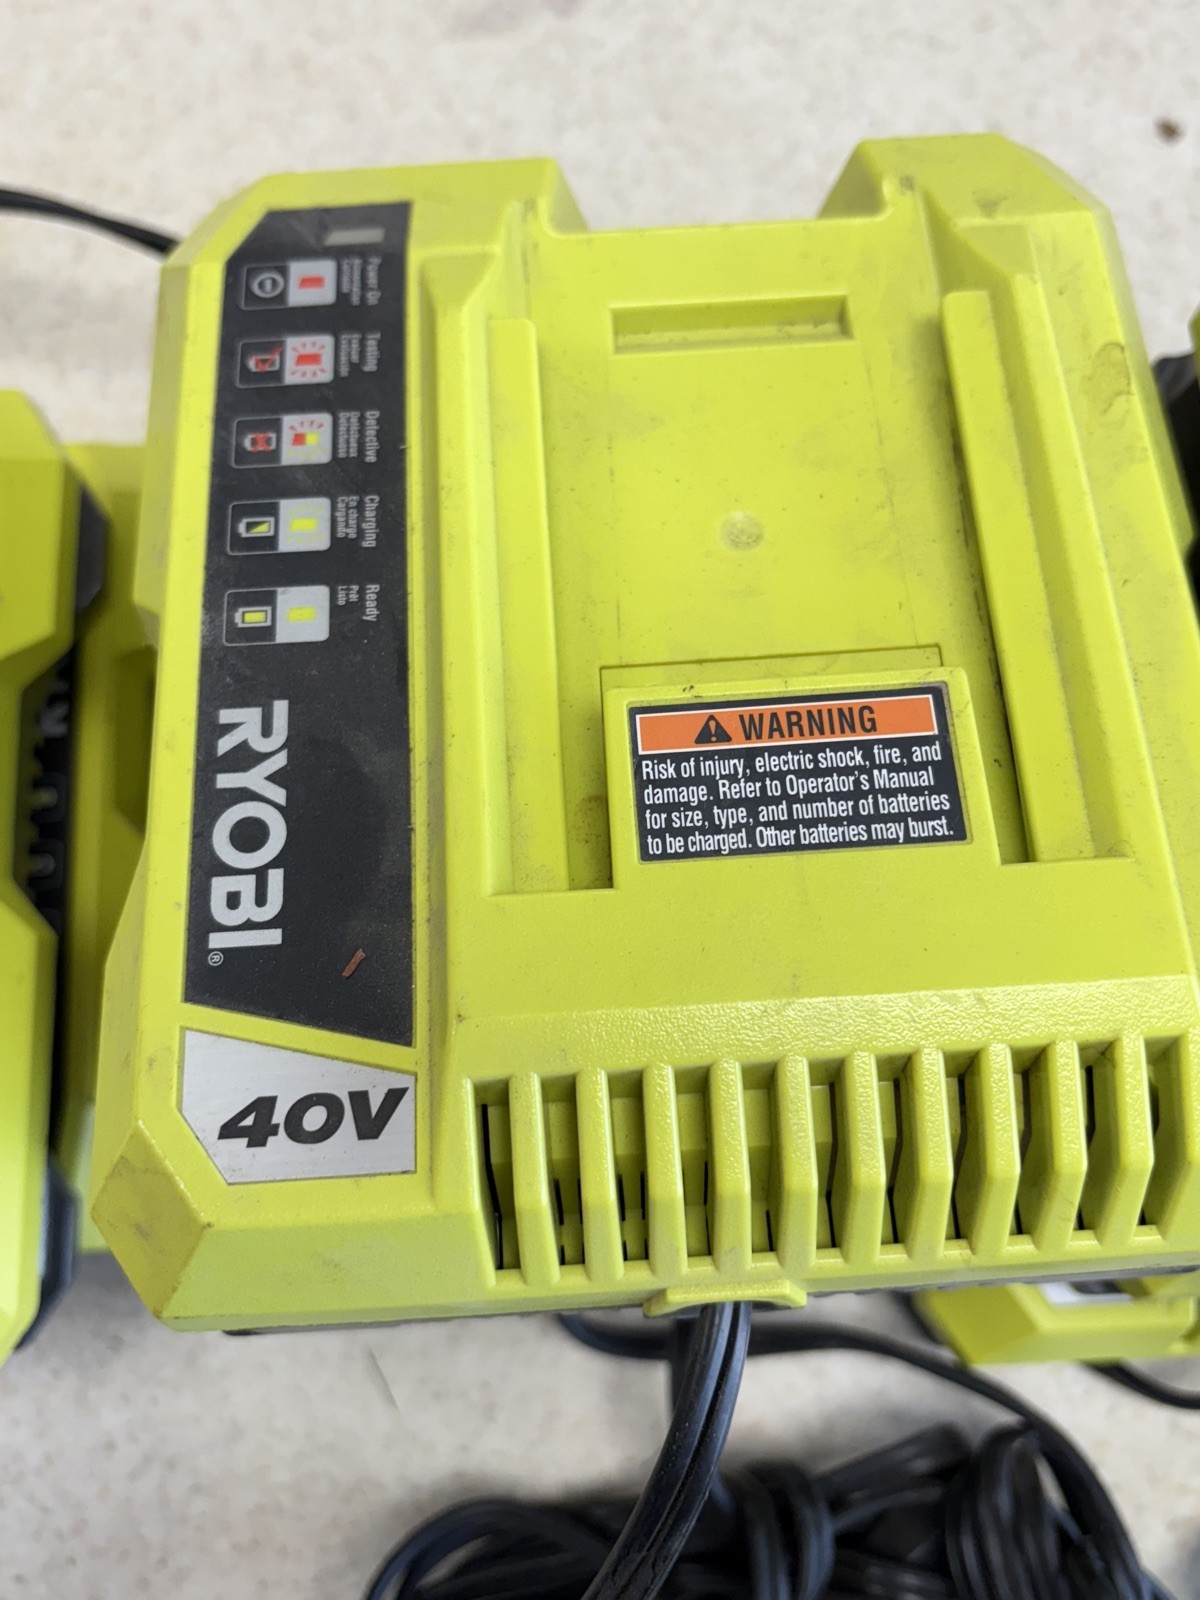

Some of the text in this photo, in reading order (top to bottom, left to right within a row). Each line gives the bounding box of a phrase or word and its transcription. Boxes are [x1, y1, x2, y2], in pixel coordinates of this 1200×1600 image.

[362, 332, 381, 371] Testing
[365, 410, 380, 463] Defective
[336, 497, 347, 538] Cargando
[347, 496, 359, 539] En charge
[362, 495, 379, 547] Charging
[338, 585, 348, 605] Listo
[362, 584, 380, 621] Ready
[739, 705, 877, 741] WARNING
[642, 741, 941, 780] Risk of injury, electric shock, fire, and
[644, 783, 713, 806] damage.
[719, 780, 762, 799] Refer
[766, 779, 781, 797] to
[874, 767, 934, 789] Manual
[645, 793, 950, 829] for size, type, and number of batteries
[648, 817, 954, 855] to be charged. Other batteries may burst.
[217, 1086, 410, 1150] 40V
